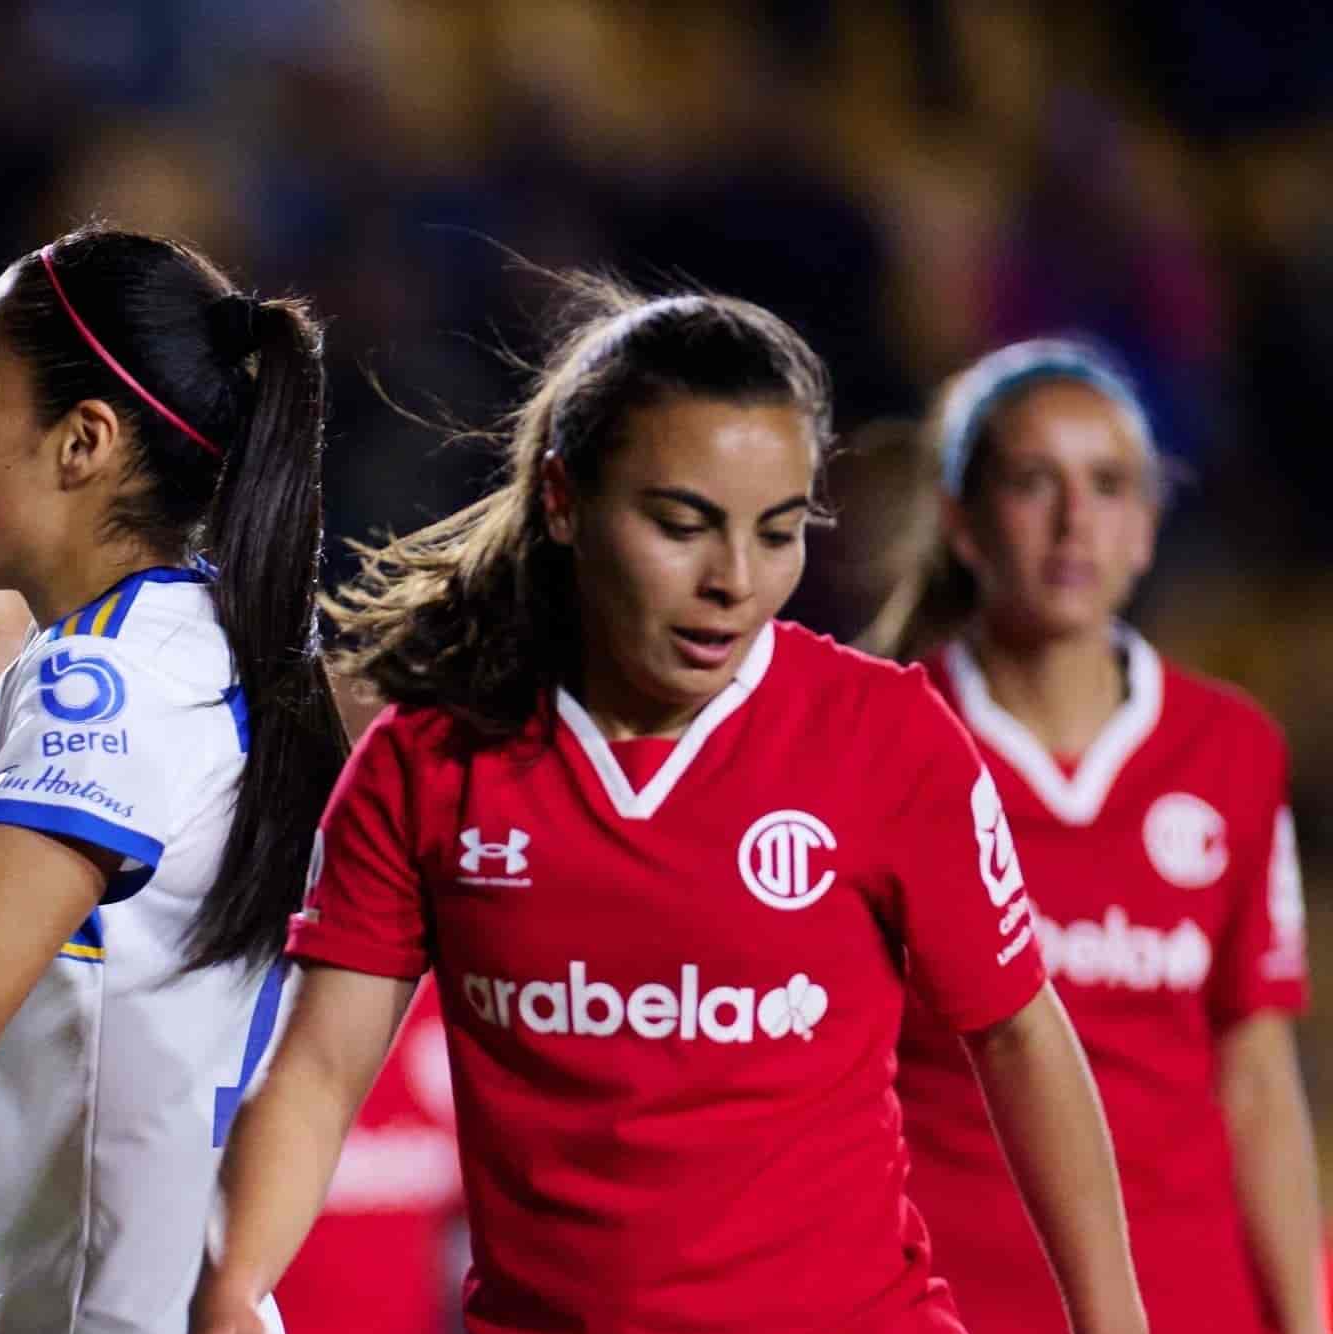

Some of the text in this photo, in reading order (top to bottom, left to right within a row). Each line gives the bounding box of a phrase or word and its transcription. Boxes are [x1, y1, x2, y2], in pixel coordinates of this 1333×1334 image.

[42, 728, 129, 760] Berel
[33, 765, 134, 818] Hortons
[463, 960, 755, 1043] arabela
